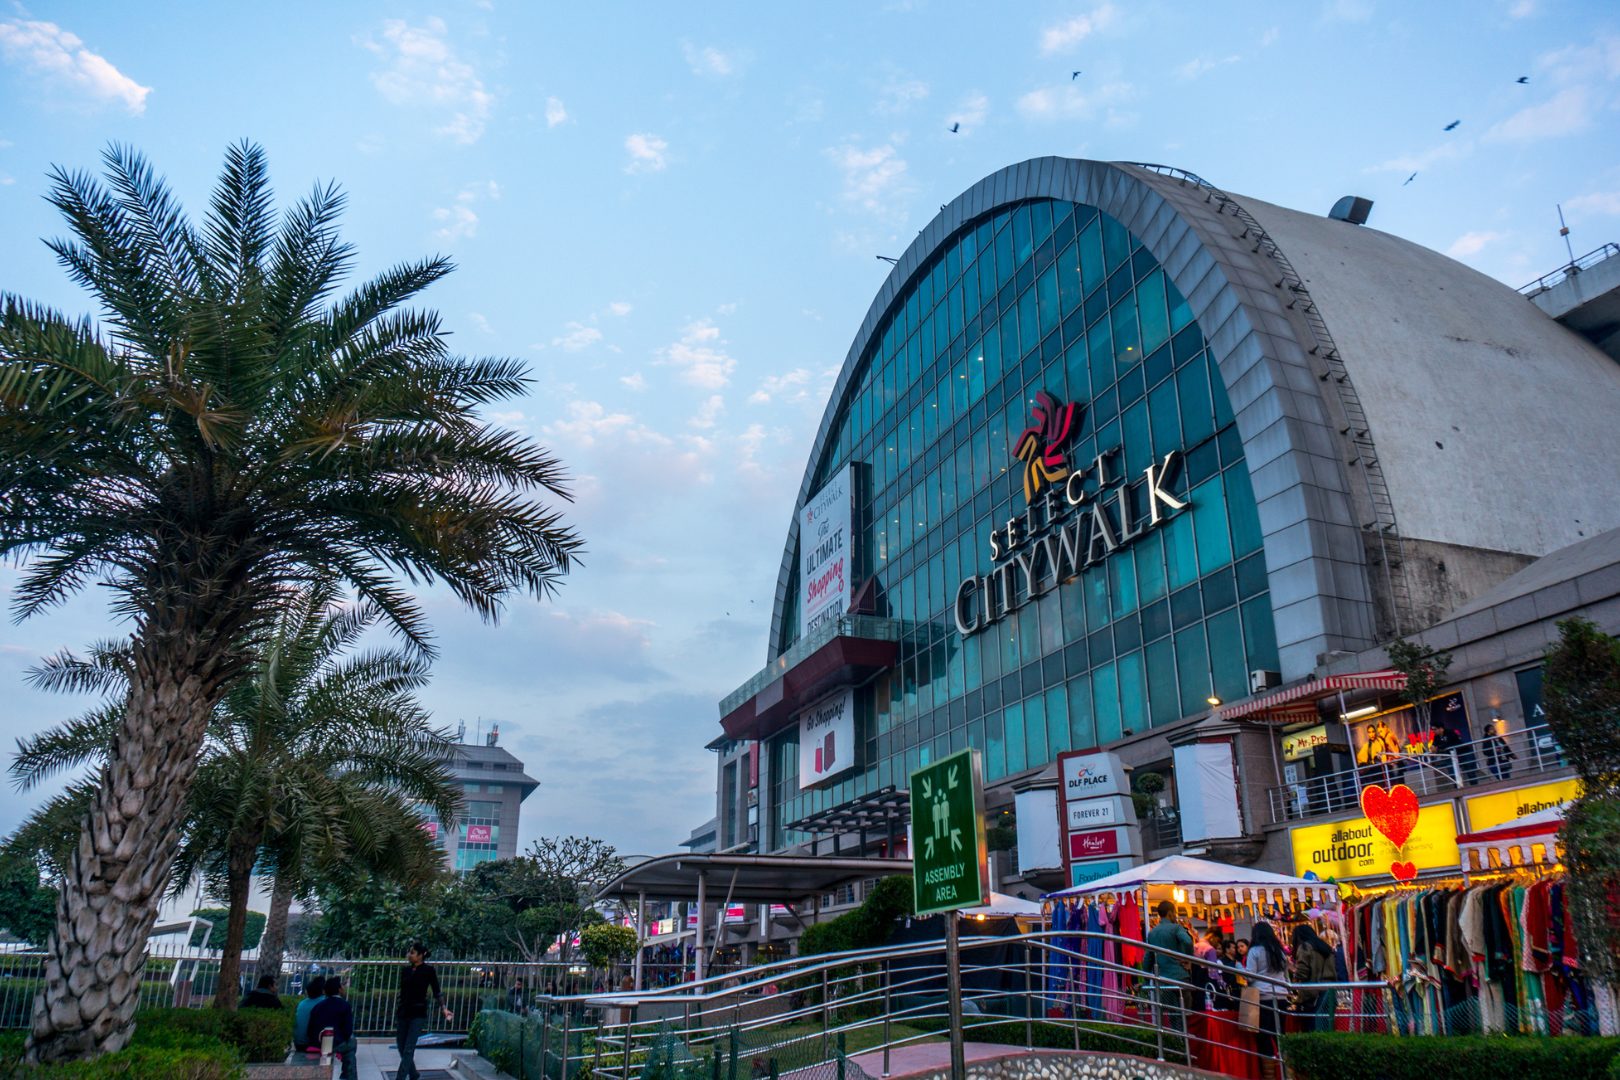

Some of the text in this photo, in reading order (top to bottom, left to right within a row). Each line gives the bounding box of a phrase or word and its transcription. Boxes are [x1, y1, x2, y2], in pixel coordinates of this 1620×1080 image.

[990, 446, 1120, 562] SELECT
[818, 517, 830, 541] The
[807, 527, 843, 575] ULTIMATE
[955, 449, 1190, 635] CITYWALK
[807, 557, 844, 604] Shopping
[807, 696, 846, 731] Go Shopping!
[1069, 779, 1083, 788] DLF
[1083, 775, 1107, 786] PLACE
[1073, 808, 1109, 820] FOREVER 21
[1331, 825, 1372, 843] allabout
[925, 862, 965, 885] ASSEMBLY
[1358, 858, 1374, 867] com
[936, 885, 958, 902] AREA
